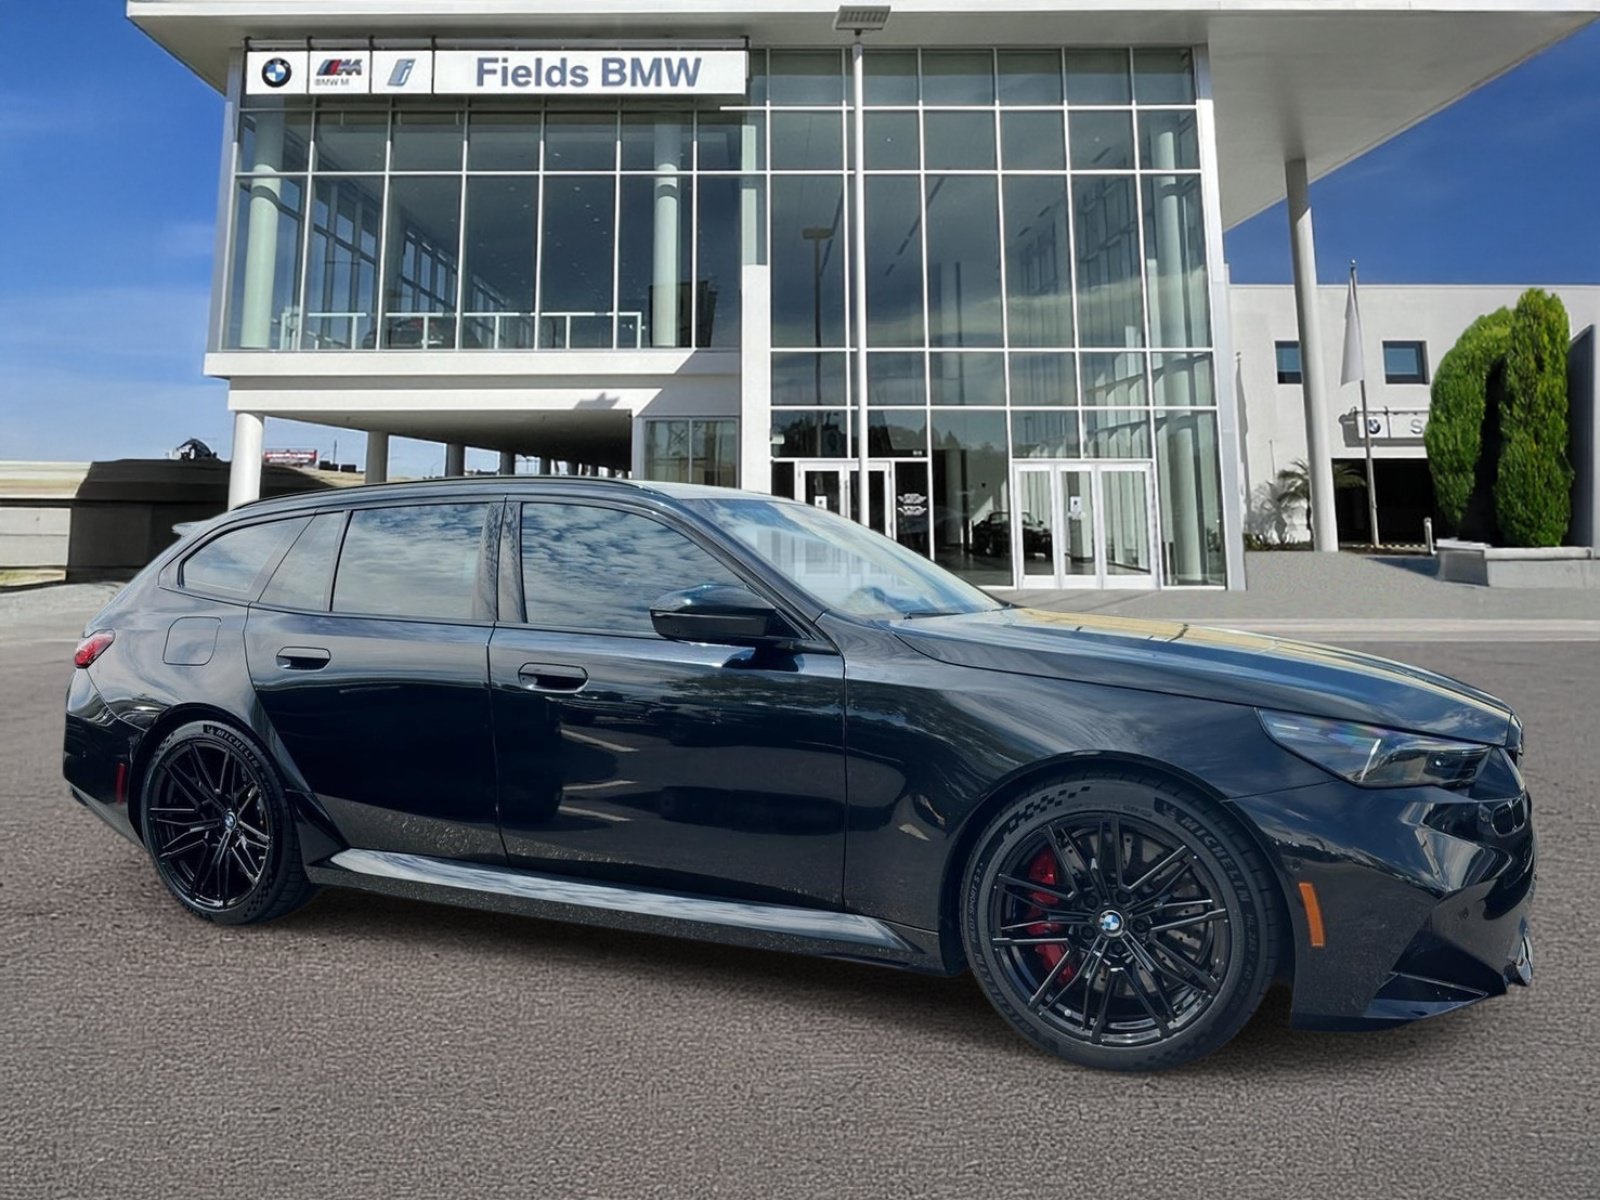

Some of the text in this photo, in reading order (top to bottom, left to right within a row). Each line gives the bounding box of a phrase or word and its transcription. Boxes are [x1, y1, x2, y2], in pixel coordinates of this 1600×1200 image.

[476, 57, 702, 87] Fields BMW
[216, 729, 260, 768] MICHELIN
[1180, 816, 1251, 902] MICHELIN
